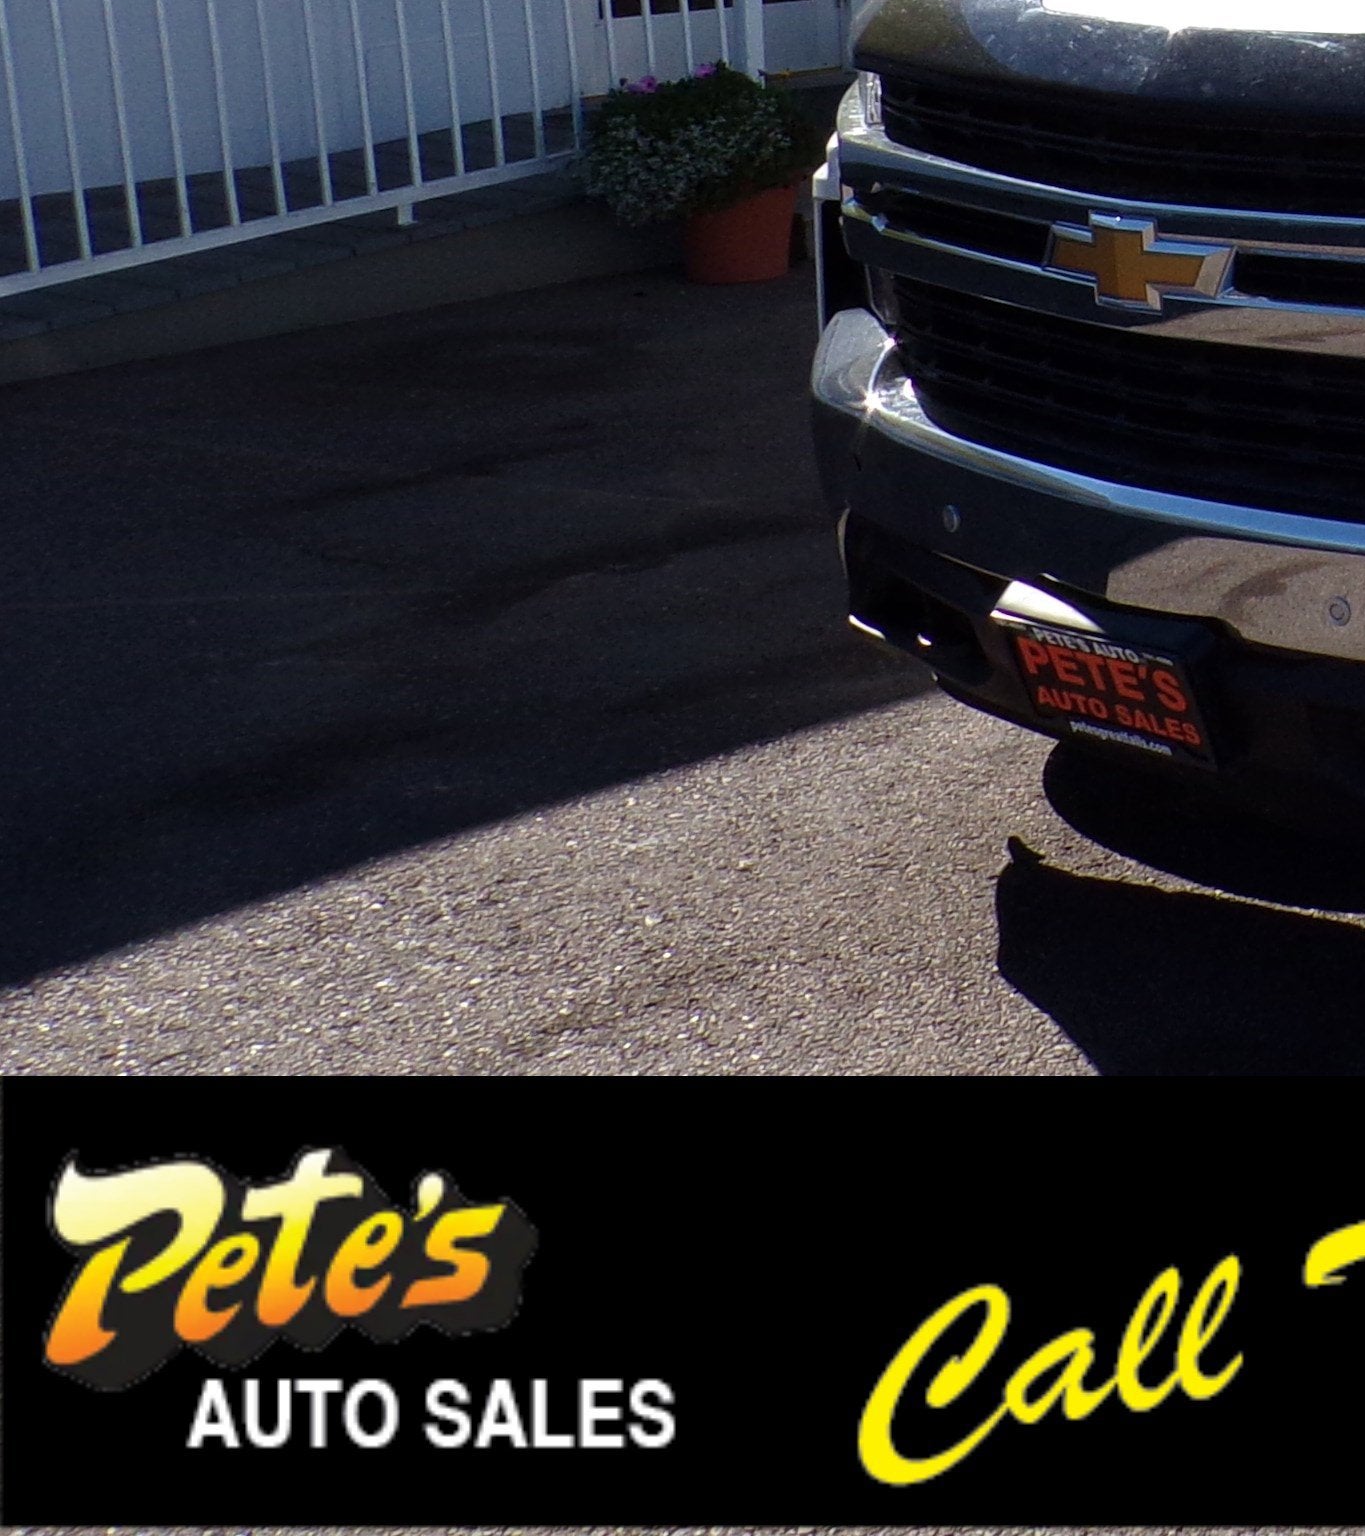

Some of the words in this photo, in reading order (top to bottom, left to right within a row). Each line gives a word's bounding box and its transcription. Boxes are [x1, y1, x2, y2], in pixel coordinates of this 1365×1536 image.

[1016, 635, 1187, 712] PETE'S
[1032, 627, 1089, 652] PETE'S
[1092, 641, 1140, 663] AUTO
[1038, 686, 1109, 719] AUTO
[1115, 703, 1200, 746] SALES
